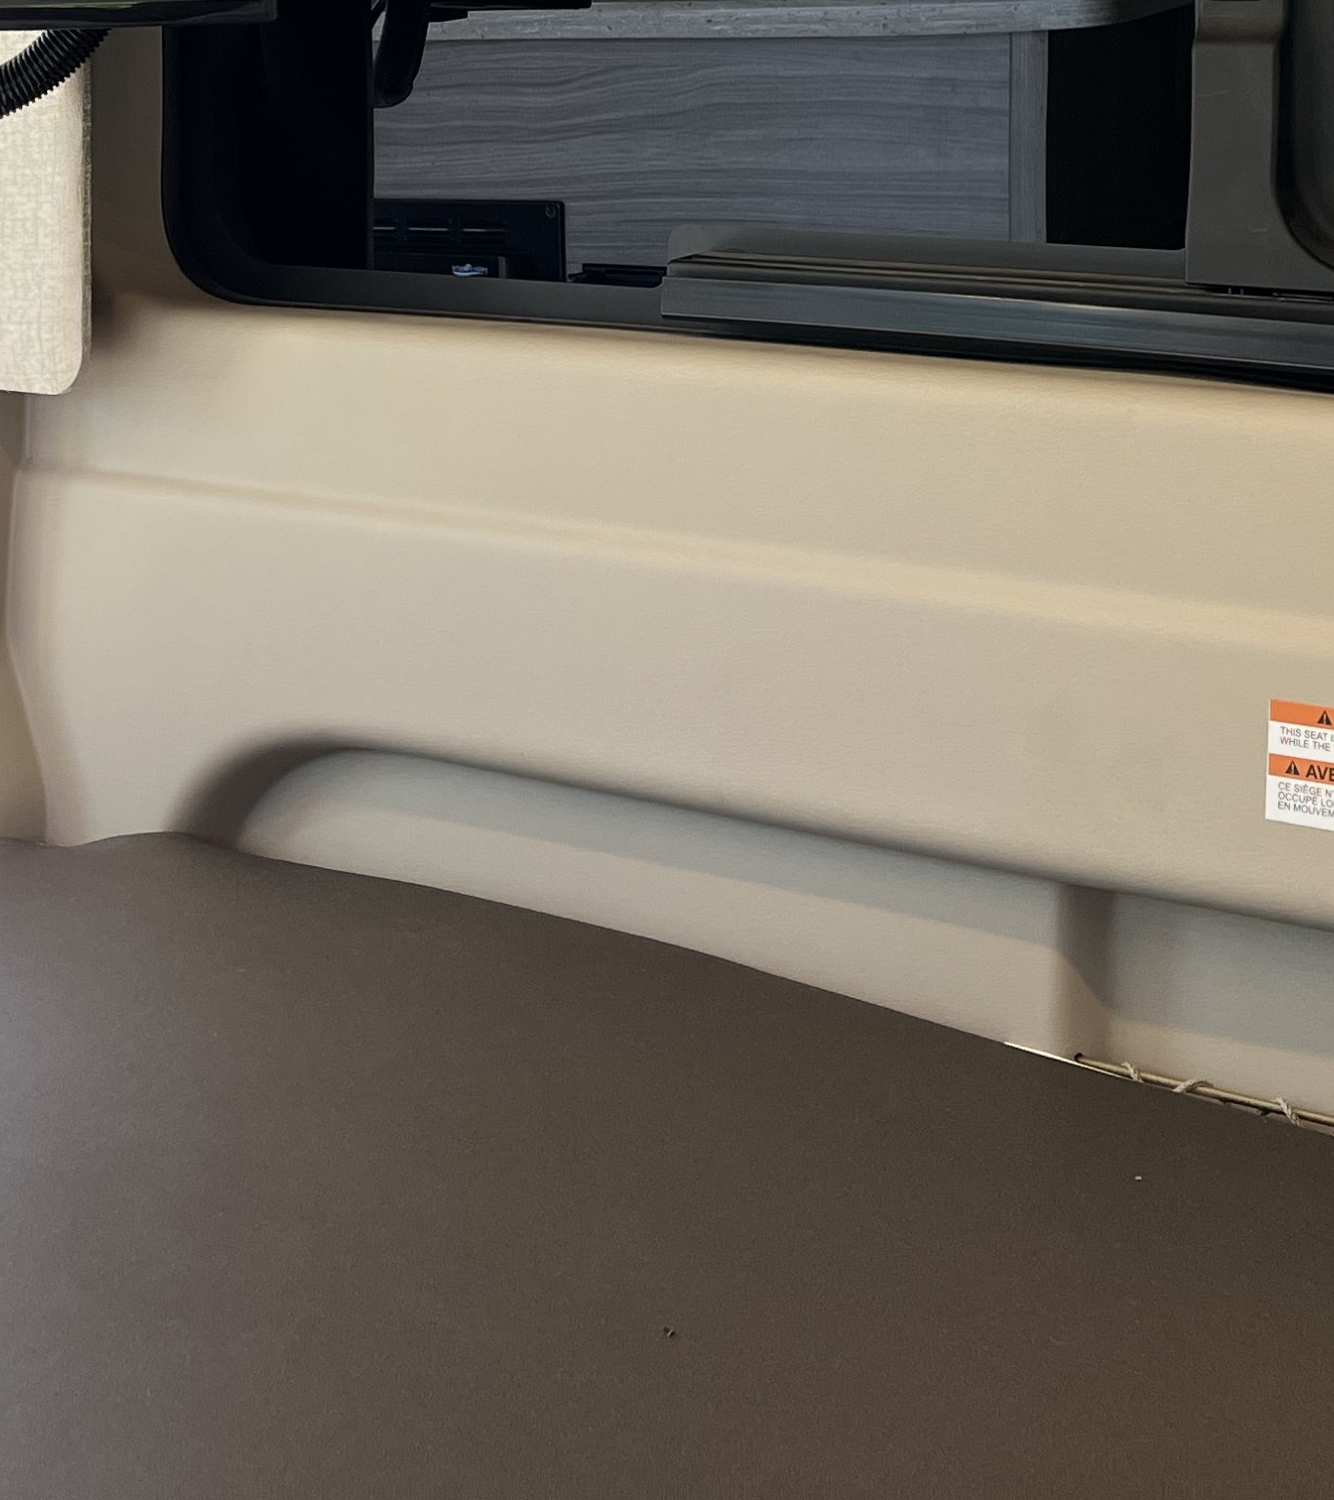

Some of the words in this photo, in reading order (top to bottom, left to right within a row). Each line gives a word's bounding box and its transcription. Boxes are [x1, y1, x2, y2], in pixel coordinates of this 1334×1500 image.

[1280, 726, 1302, 737] THIS
[1304, 730, 1328, 741] SEAT
[1280, 736, 1309, 748] WHILE
[1312, 741, 1331, 752] THE
[1278, 781, 1292, 792] CE
[1277, 800, 1291, 810] EN
